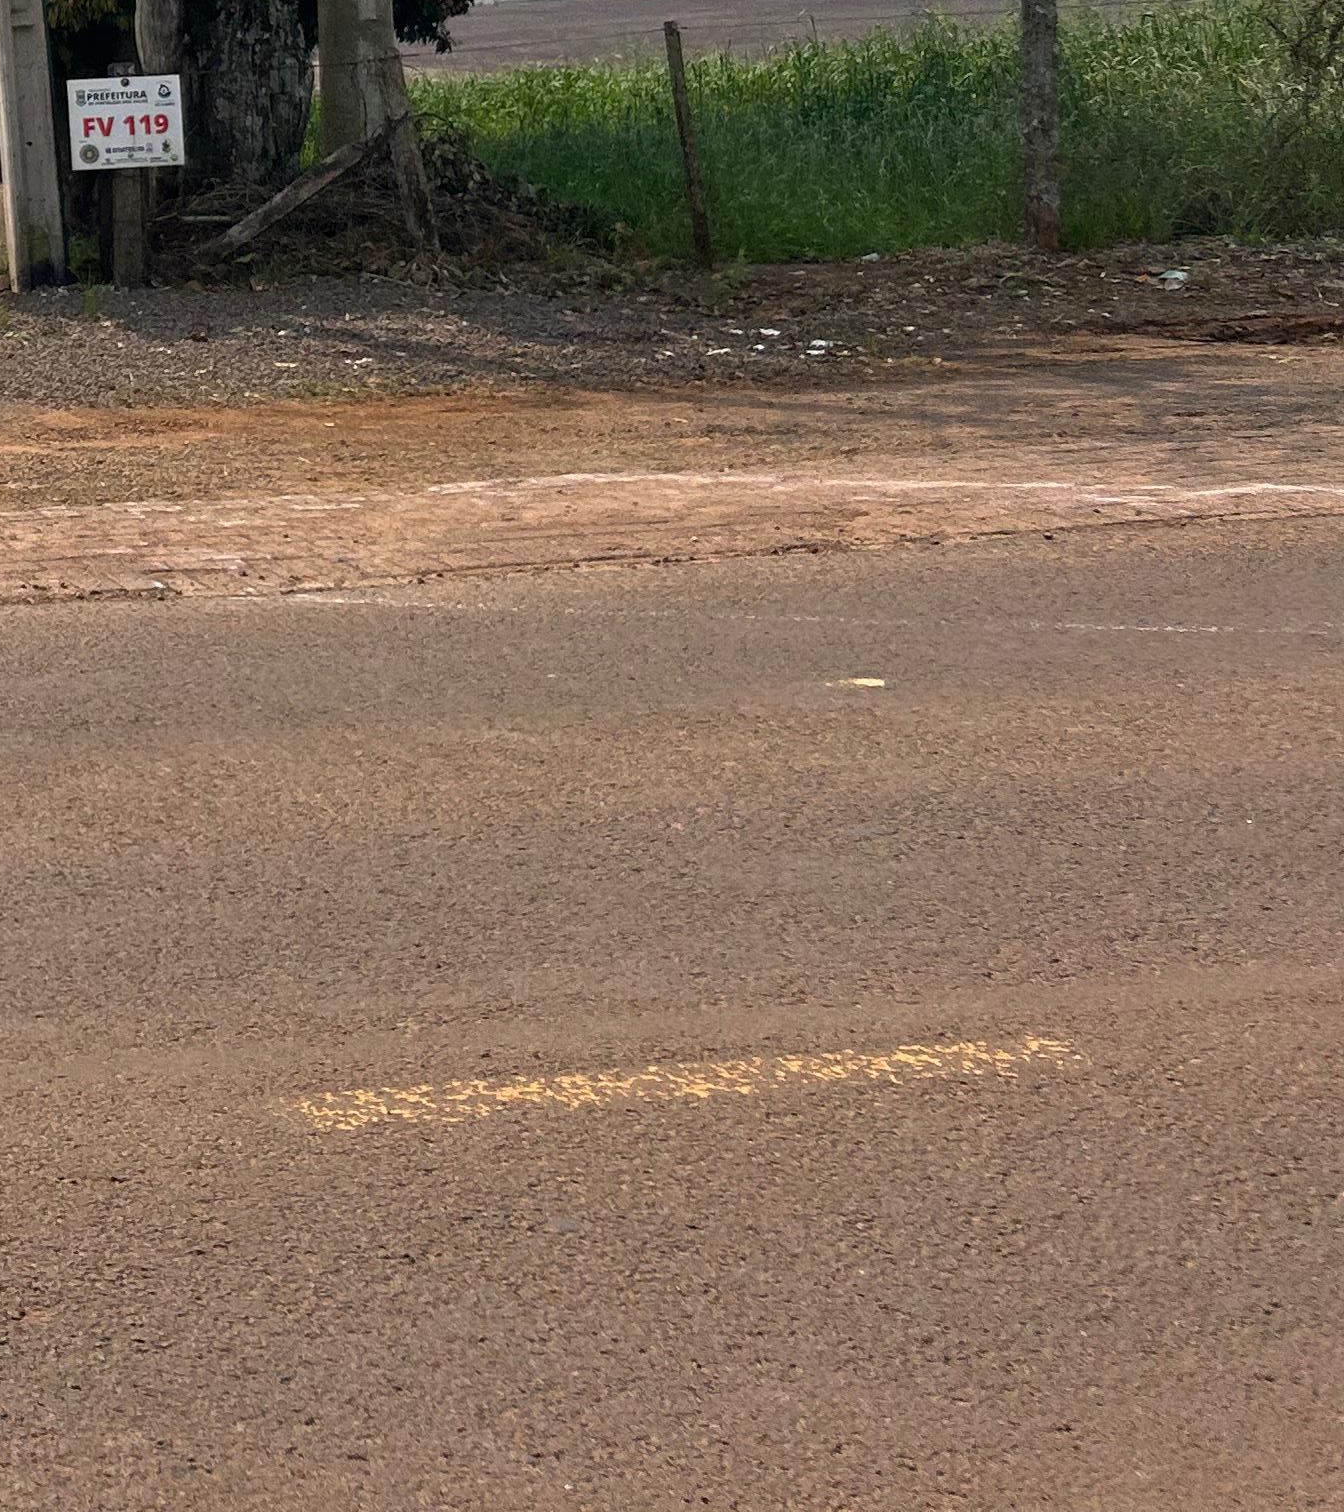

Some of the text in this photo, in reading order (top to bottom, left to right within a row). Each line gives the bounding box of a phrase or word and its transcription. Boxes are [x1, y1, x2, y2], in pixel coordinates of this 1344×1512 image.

[87, 90, 147, 101] PREFEITURA
[83, 113, 169, 138] FV 119
